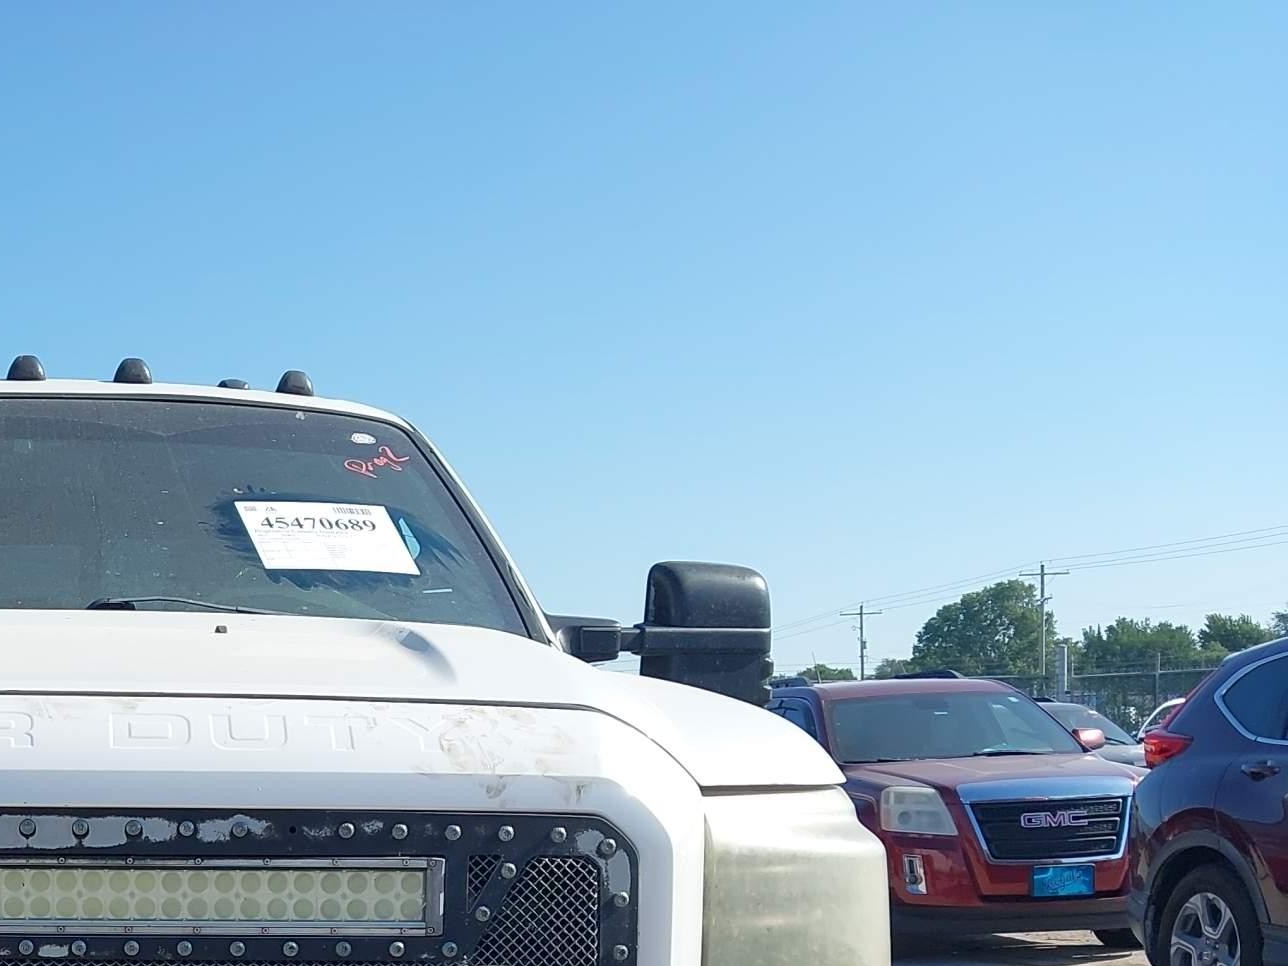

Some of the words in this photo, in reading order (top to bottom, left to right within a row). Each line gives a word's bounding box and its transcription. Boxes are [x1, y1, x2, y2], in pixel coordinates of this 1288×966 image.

[261, 516, 377, 532] 45470689
[108, 711, 457, 752] DUTY
[1021, 810, 1088, 828] GMC
